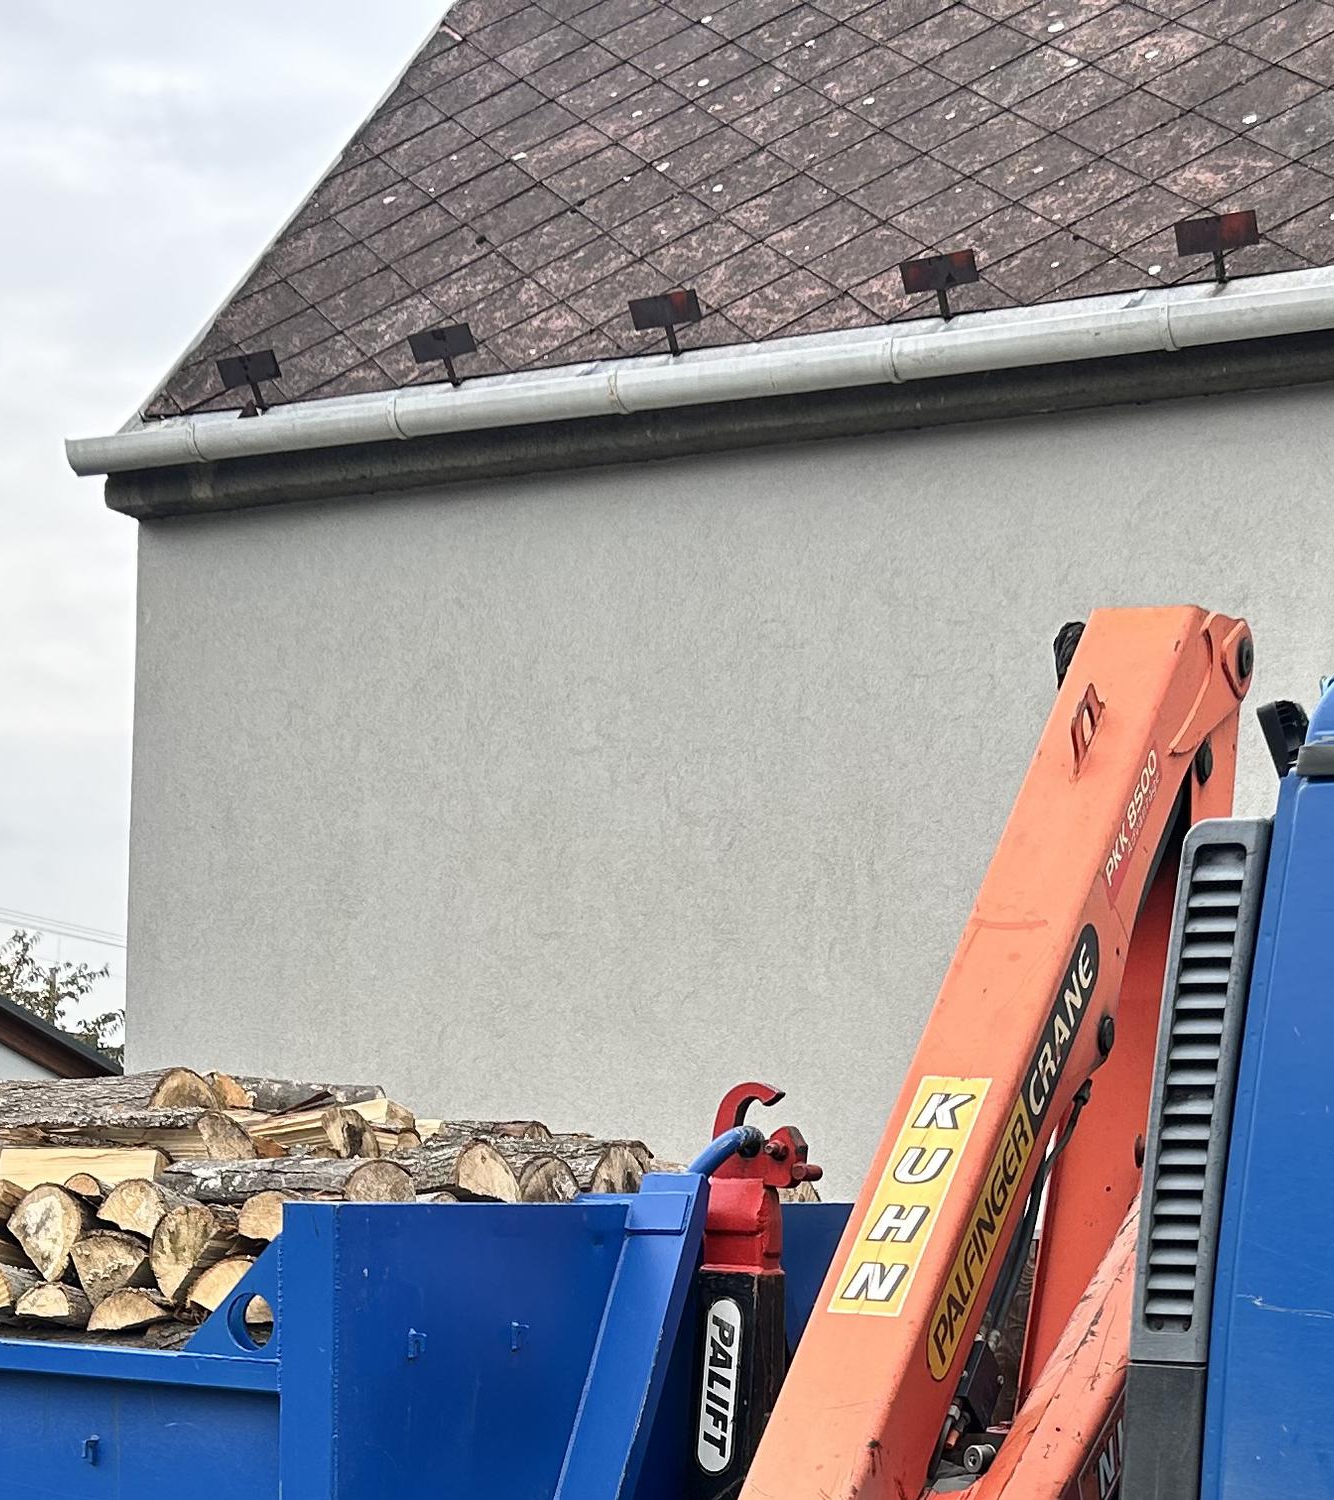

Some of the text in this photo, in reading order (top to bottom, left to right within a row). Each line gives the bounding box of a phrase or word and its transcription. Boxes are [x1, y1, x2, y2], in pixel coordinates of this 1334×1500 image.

[1105, 750, 1157, 887] PKK 8500
[840, 1092, 976, 1302] KUHN
[931, 942, 1094, 1367] PALFINGER CRANE
[703, 1314, 736, 1459] PALIFT
